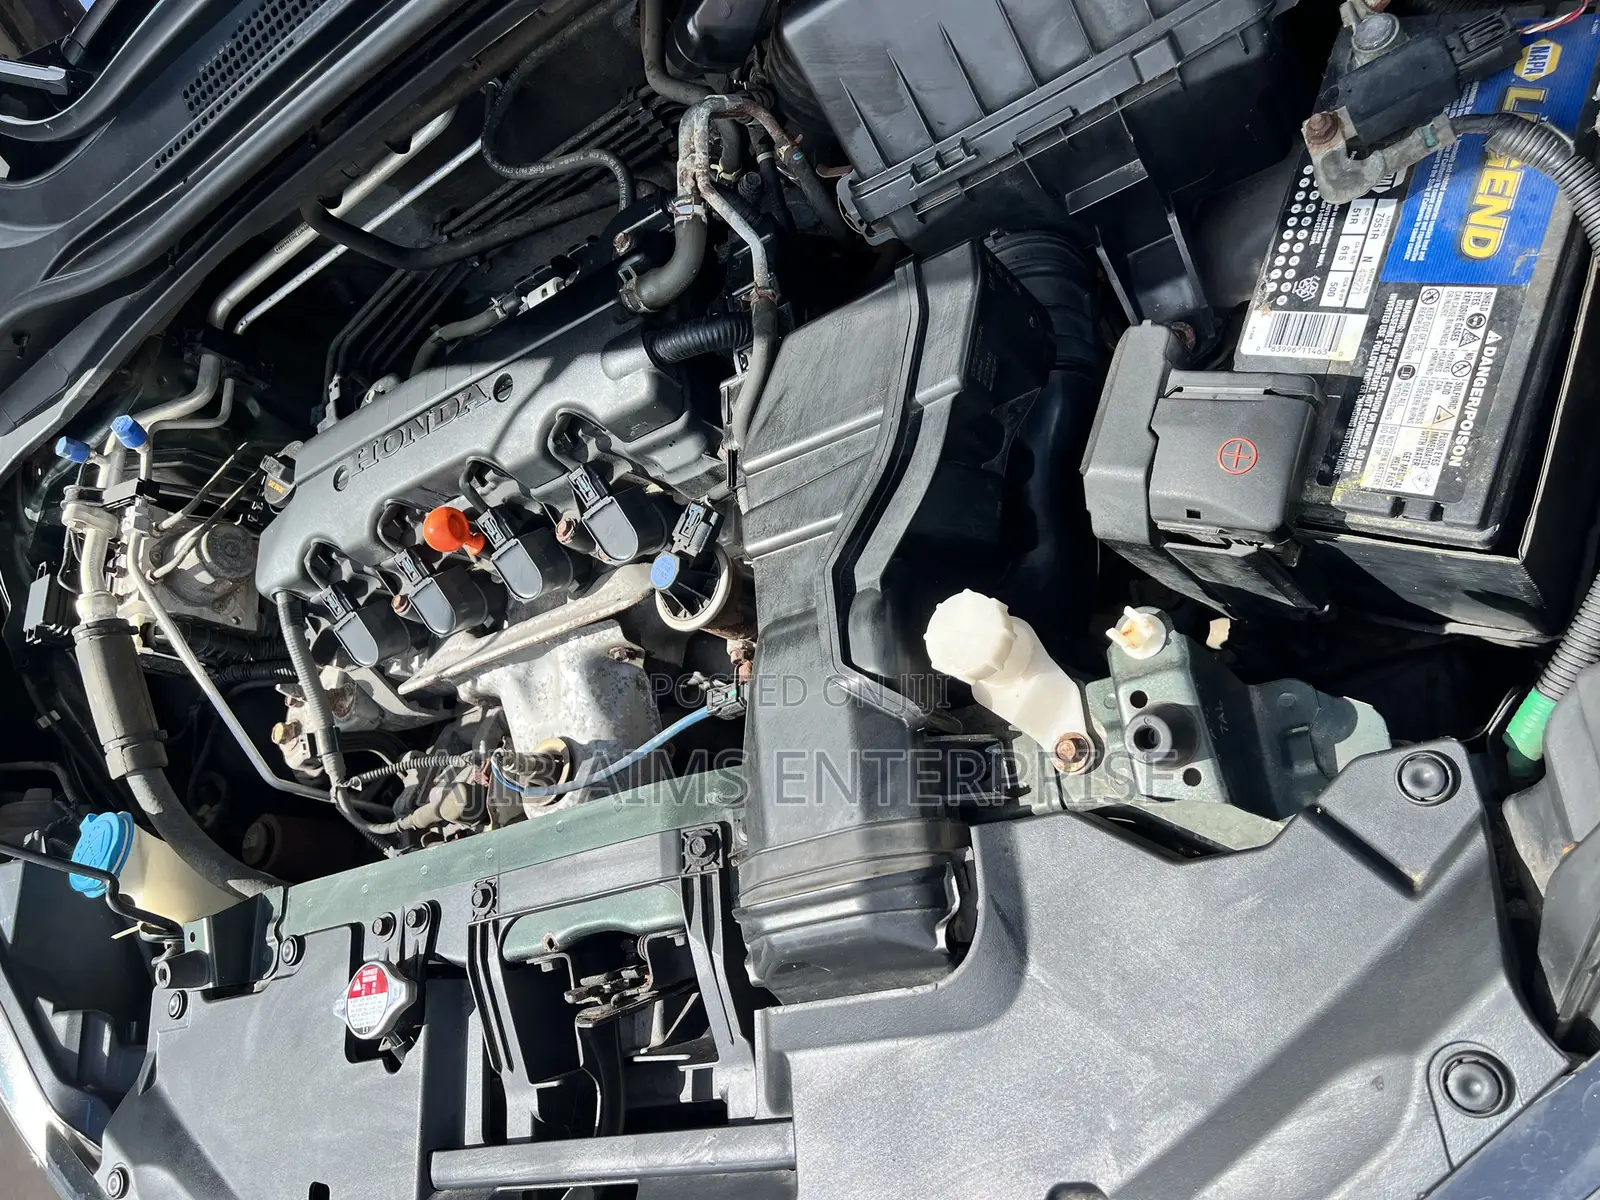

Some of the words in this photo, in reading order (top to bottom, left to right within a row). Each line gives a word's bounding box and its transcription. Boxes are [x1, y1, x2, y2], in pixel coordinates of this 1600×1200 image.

[1523, 45, 1551, 75] NAPA
[1428, 188, 1438, 203] cause
[1415, 198, 1428, 221] California
[1422, 204, 1433, 221] cancer
[1430, 191, 1445, 219] accessories
[1348, 207, 1361, 224] 51R
[1369, 212, 1385, 239] 7551R
[1420, 221, 1428, 230] and
[1424, 221, 1435, 238] contain
[1409, 228, 1419, 242] cause
[1337, 245, 1349, 260] 615
[1409, 231, 1425, 261] reproductive
[1420, 239, 1429, 250] lead
[1417, 251, 1426, 260] and
[1326, 281, 1338, 297] 500
[1452, 291, 1462, 300] CAN
[1455, 291, 1473, 321] EXPLOSIVE
[1469, 291, 1482, 307] EYES.
[1478, 291, 1493, 311] SHIELD
[1380, 293, 1397, 323] INVERTED
[1396, 299, 1413, 331] WARNING:
[1414, 306, 1426, 324] REACH
[1424, 306, 1435, 319] KEEP
[1447, 302, 1459, 317] CAUSE
[1383, 299, 1404, 342] DISASSEMBLE
[1420, 321, 1430, 332] OUT
[1375, 324, 1387, 338] USE.
[1391, 332, 1403, 347] RISK
[1438, 319, 1453, 345] BLINDNESS
[1449, 322, 1463, 341] GASES
[1302, 346, 1327, 355] 11463
[1367, 340, 1382, 366] FOLLOW
[1403, 333, 1418, 359] CHILDREN
[1414, 342, 1424, 351] THE
[1367, 354, 1387, 392] INCINERATE.
[1381, 358, 1395, 374] FIRE,
[1358, 367, 1374, 392] PROPER
[1434, 380, 1443, 390] CAN
[1440, 381, 1453, 394] ACID
[1370, 376, 1389, 412] EXPLOSION
[1400, 382, 1411, 395] READ
[1422, 379, 1435, 399] CAUSE
[1447, 381, 1464, 409] SULFURIC
[1362, 394, 1374, 406] NOT
[1396, 398, 1406, 407] ALL
[1446, 346, 1497, 466] DANGER/POISON
[1347, 394, 1365, 426] CHARGING
[1414, 401, 1428, 424] BLINDNESS
[351, 381, 491, 478] HONDA
[1347, 408, 1369, 456] RECOMMENDED
[1359, 423, 1374, 447] BURNS.
[1417, 430, 1430, 445] WITH
[1376, 434, 1386, 445] NOT
[1384, 435, 1394, 446] NOT
[1434, 432, 1449, 450] FLUSH
[1332, 428, 1354, 475] INSTRUCTIONS.
[1379, 447, 1390, 461] OPEN
[1401, 451, 1412, 462] GET
[1409, 446, 1424, 467] WATER.
[1418, 431, 1439, 469] IMMEDIATELY
[1429, 451, 1442, 466] EYES
[1342, 458, 1353, 471] FOR
[1351, 460, 1362, 473] NOT
[1388, 456, 1401, 470] HELP
[1392, 464, 1408, 488] MEDICAL
